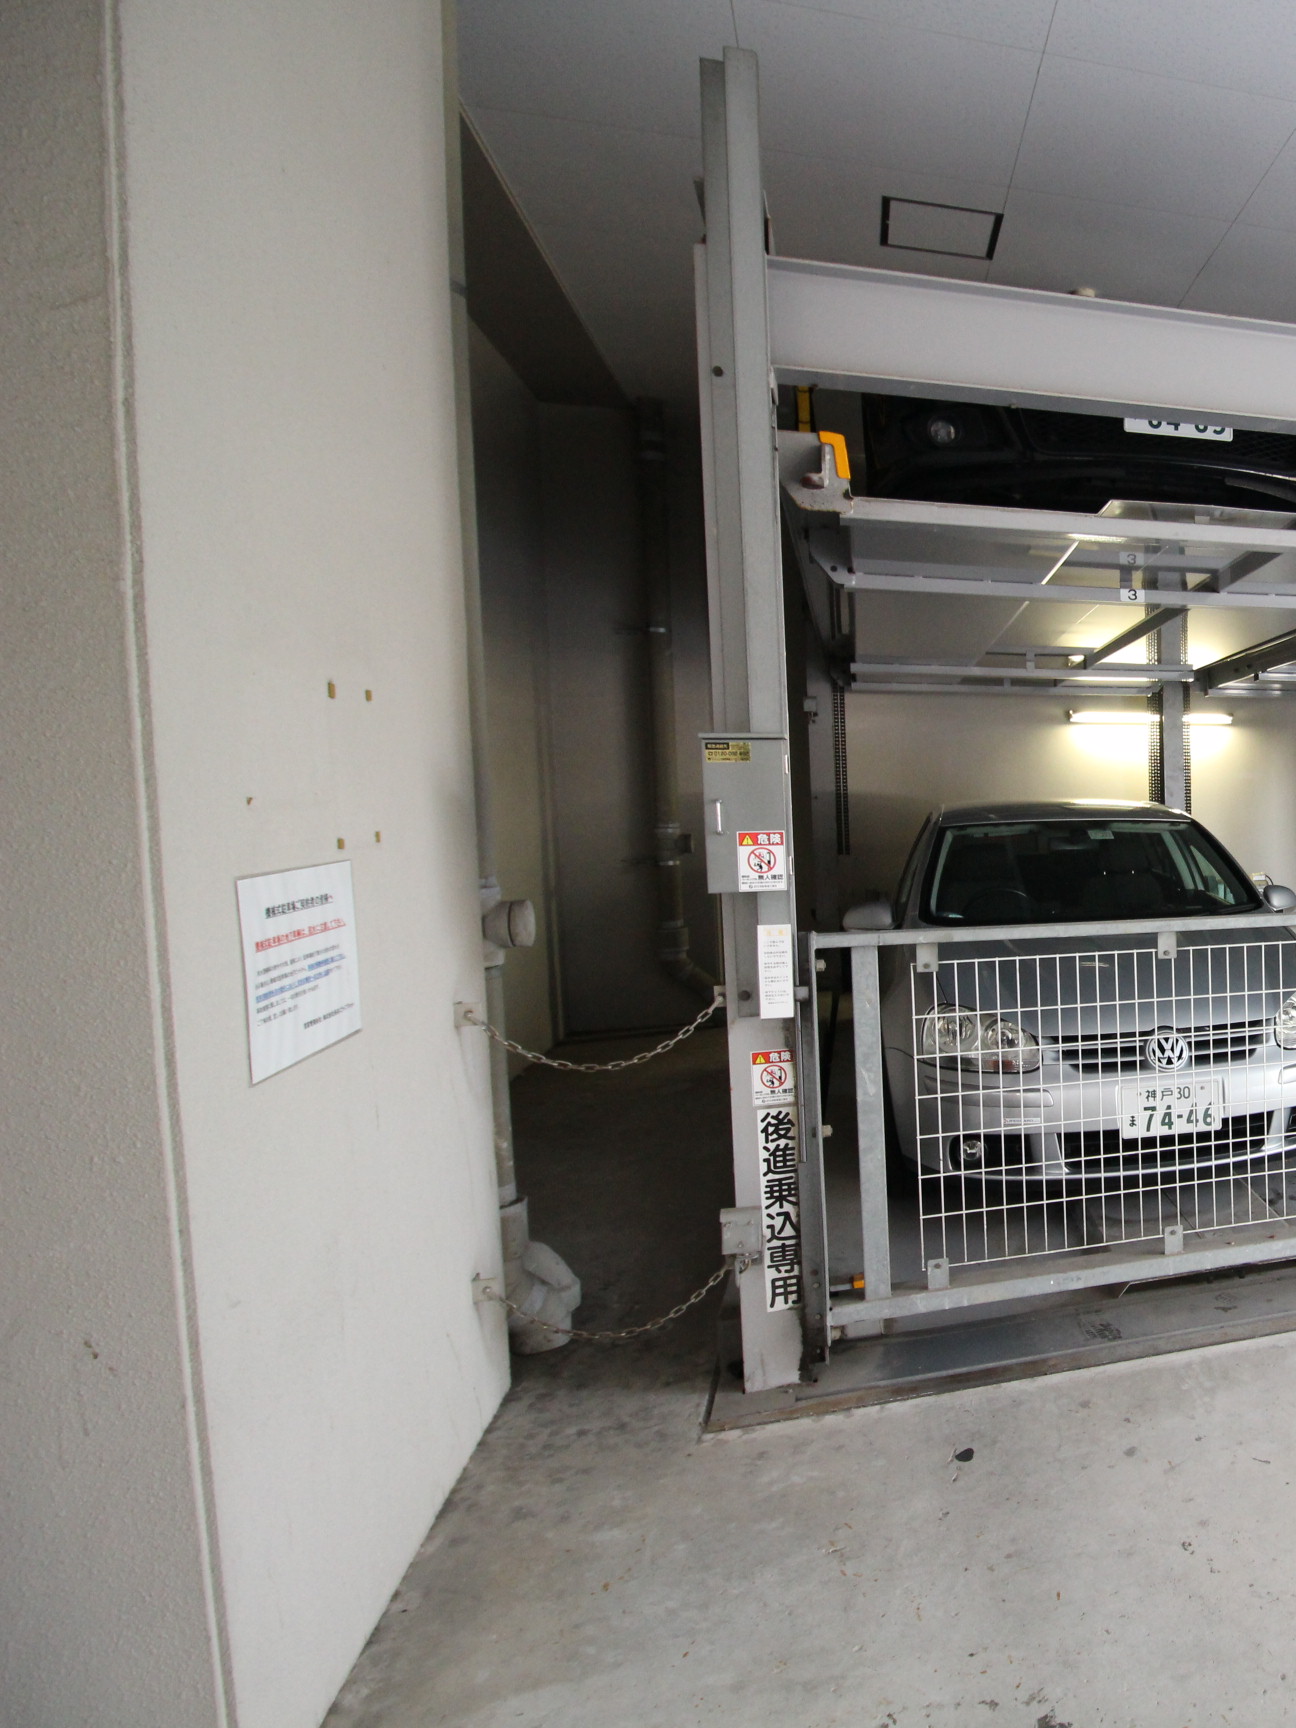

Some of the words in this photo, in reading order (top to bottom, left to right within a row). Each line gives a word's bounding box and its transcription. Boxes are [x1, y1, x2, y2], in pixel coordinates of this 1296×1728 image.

[1128, 589, 1138, 600] 3
[756, 833, 782, 844] 危険
[769, 1051, 792, 1063] 危険
[1129, 1115, 1137, 1128] ま
[1143, 1101, 1216, 1133] 74-46
[760, 1110, 801, 1309] 後進乗込専用
